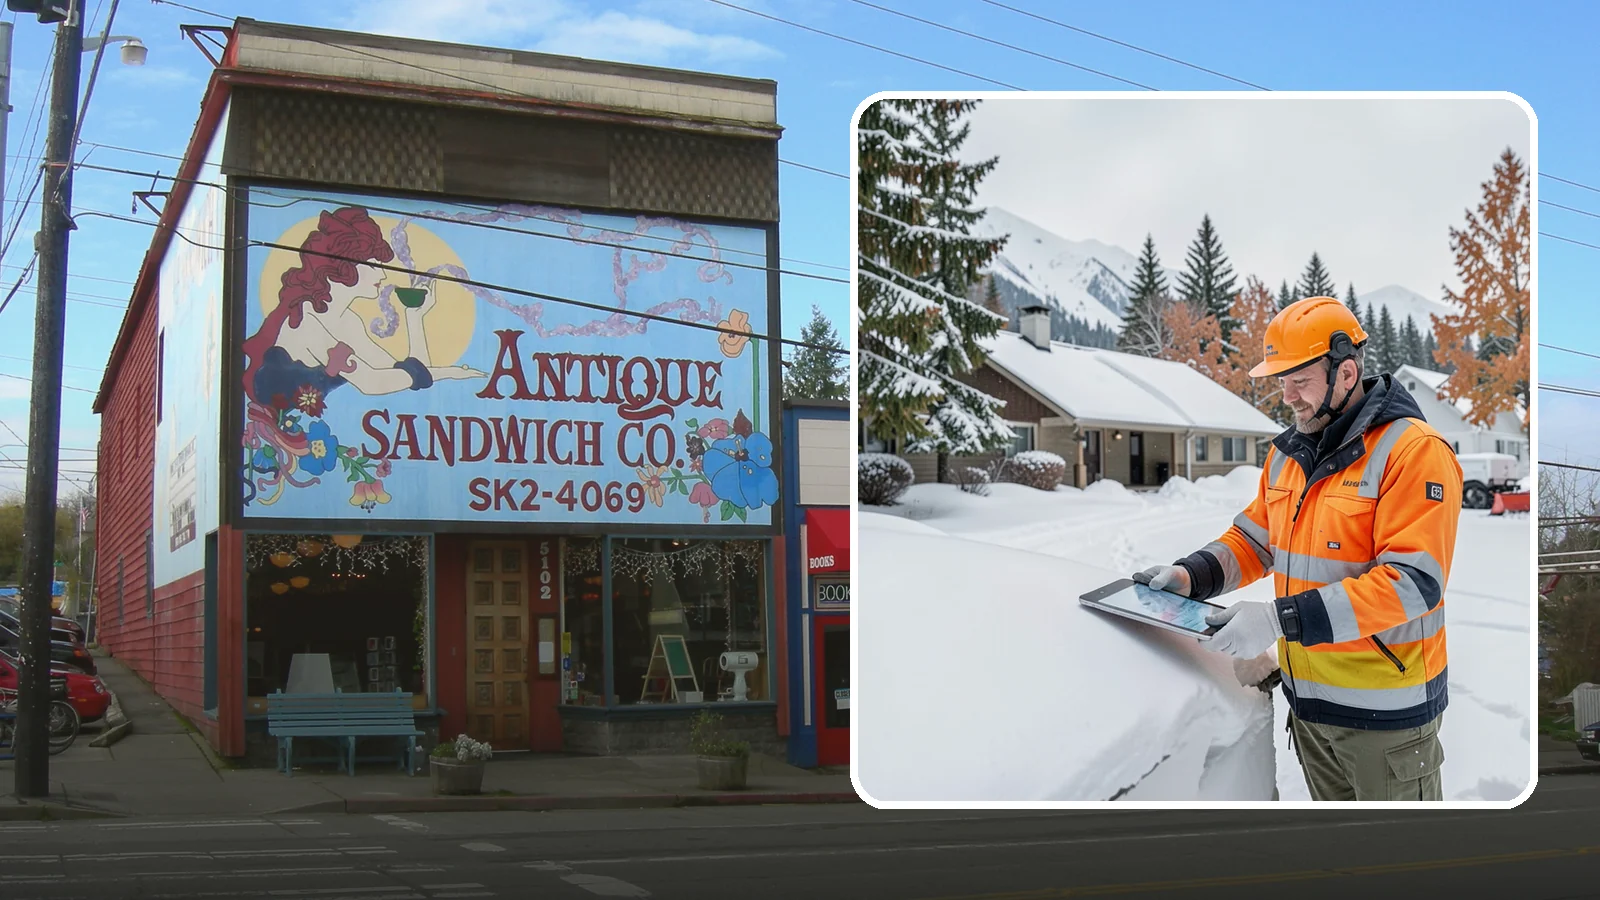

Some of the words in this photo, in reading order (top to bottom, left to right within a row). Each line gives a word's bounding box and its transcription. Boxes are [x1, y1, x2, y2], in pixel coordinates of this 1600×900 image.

[476, 329, 723, 420] ANTIQUE
[362, 408, 605, 466] SANDWICH
[617, 422, 685, 468] CO.
[468, 477, 645, 513] SK2-4069
[540, 542, 551, 599] 5102
[809, 555, 835, 569] BOOKS
